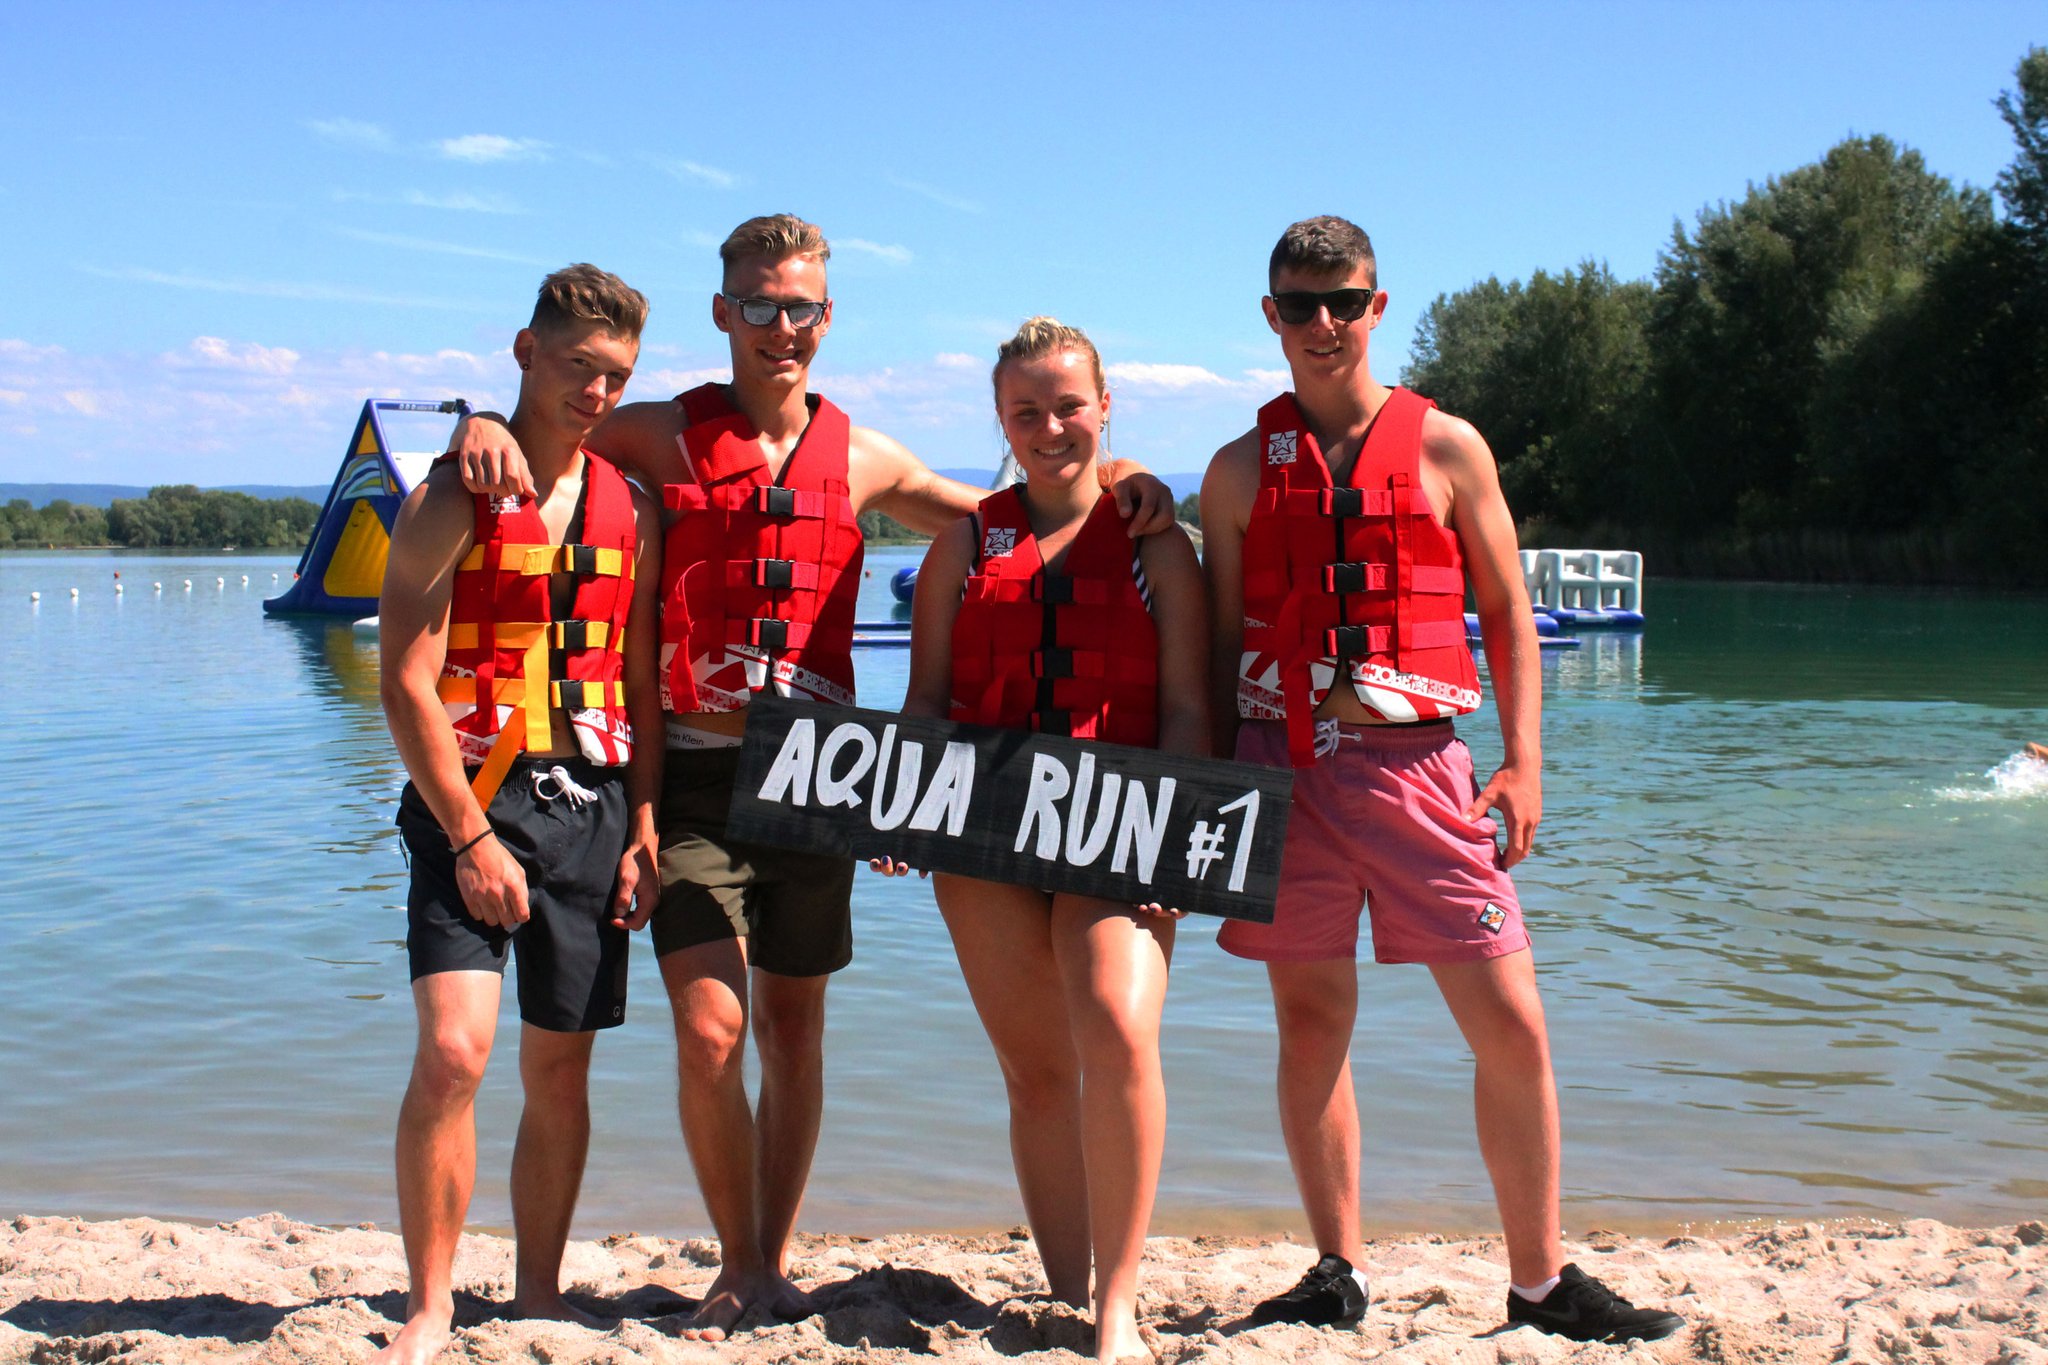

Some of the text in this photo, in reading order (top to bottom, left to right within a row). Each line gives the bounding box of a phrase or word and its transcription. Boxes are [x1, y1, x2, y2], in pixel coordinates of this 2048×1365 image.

[490, 502, 521, 513] JOBE
[682, 733, 705, 746] Klein
[757, 718, 1261, 893] AQUA RUN #1
